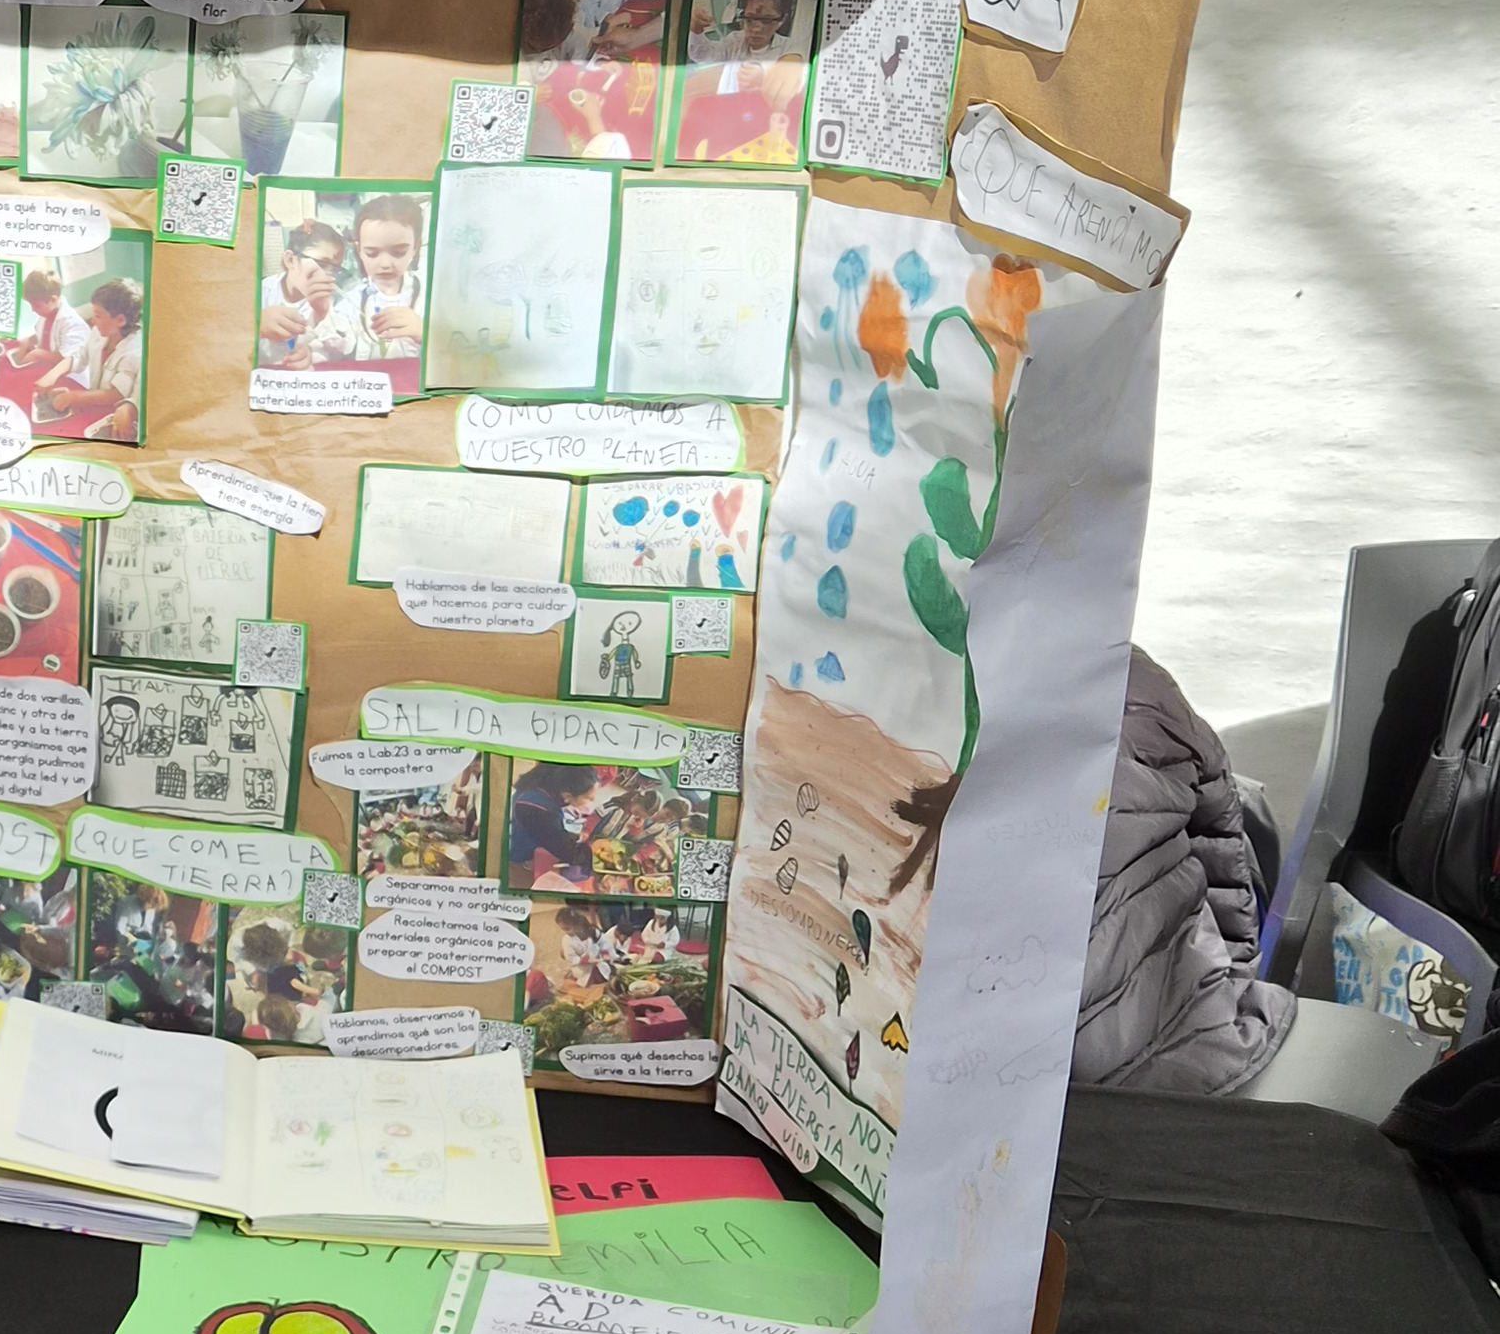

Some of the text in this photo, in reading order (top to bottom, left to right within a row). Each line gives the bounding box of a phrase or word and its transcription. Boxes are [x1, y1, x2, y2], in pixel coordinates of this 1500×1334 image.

[467, 401, 553, 428] COMO
[706, 408, 727, 431] A
[466, 435, 586, 465] NUESTRO
[168, 835, 261, 865] COME
[288, 843, 328, 865] LA
[394, 915, 499, 932] Recolectamos los
[366, 931, 526, 951] materiales orgánicos para
[367, 948, 524, 965] preparar posteriormente
[406, 964, 483, 977] el COMPOST
[538, 1282, 643, 1306] QUERIDA
